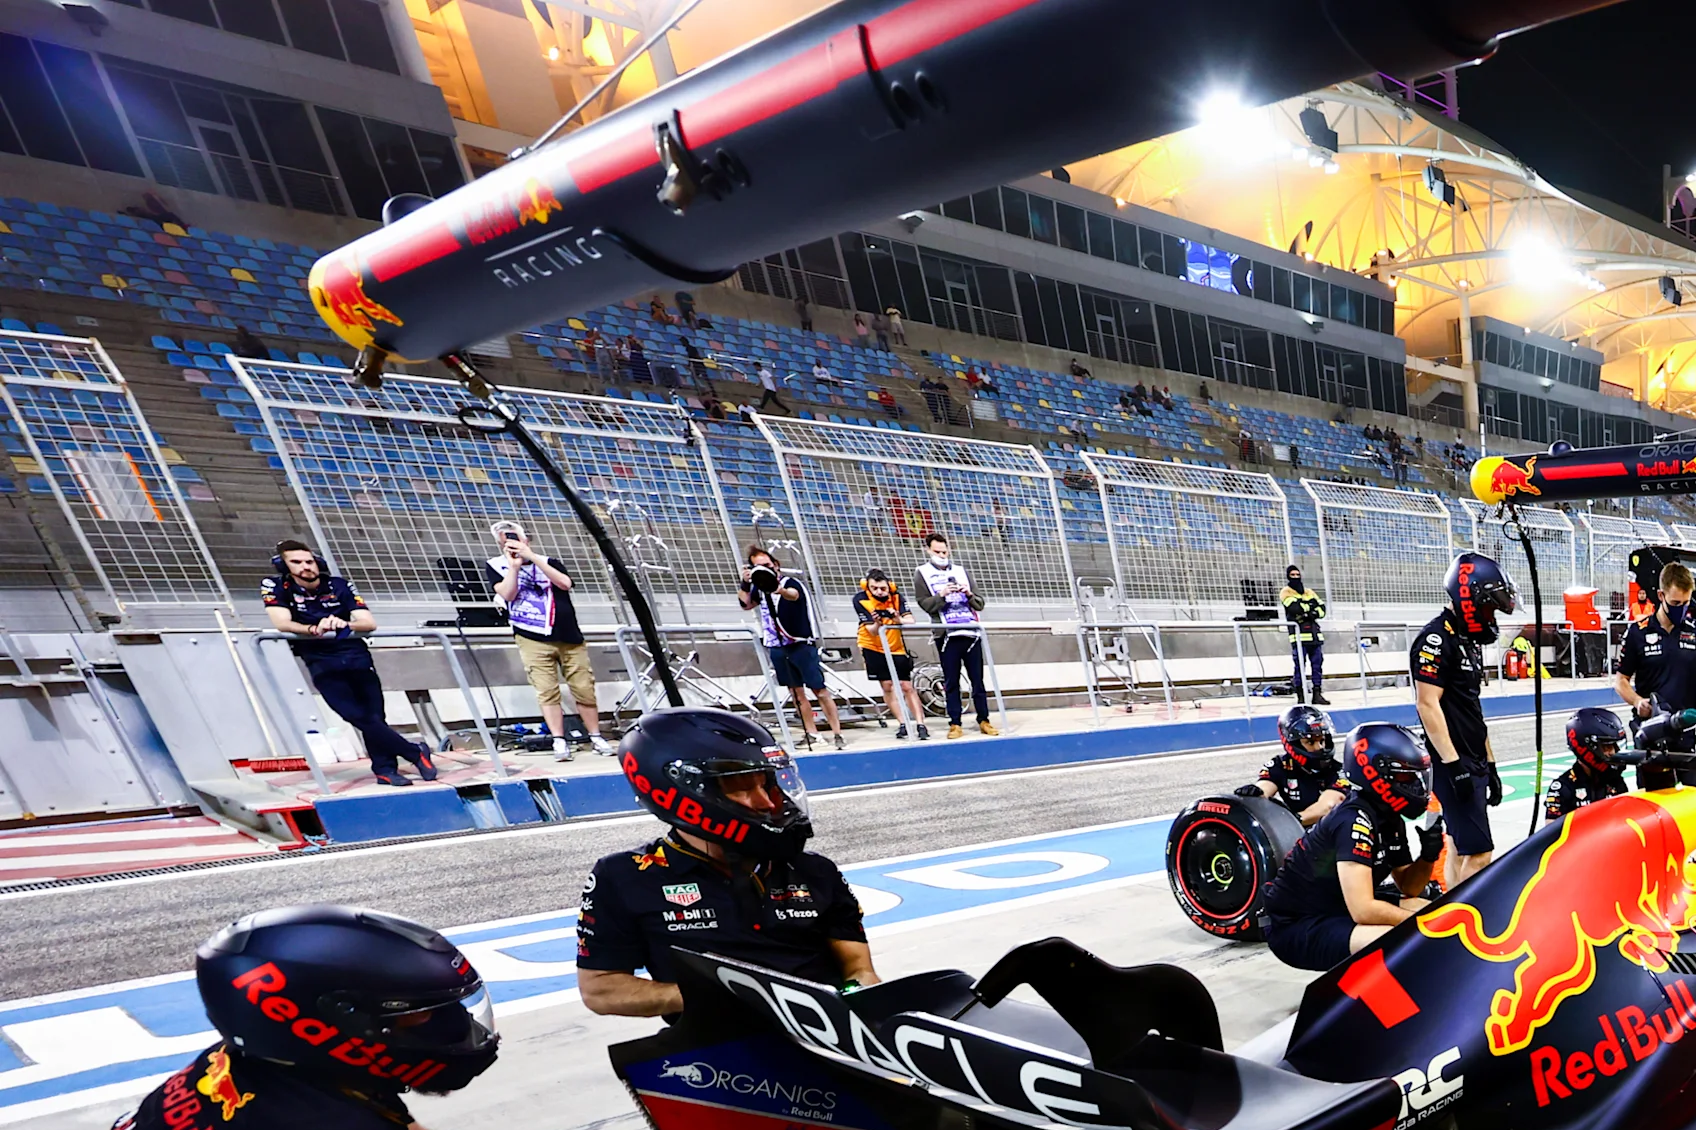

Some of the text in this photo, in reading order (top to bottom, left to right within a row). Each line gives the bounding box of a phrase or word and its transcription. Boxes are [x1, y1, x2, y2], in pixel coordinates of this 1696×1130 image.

[493, 236, 602, 288] RACING
[1352, 738, 1409, 812] Red Bull
[622, 751, 750, 843] Red Bull
[1198, 802, 1231, 815] PIRELLI
[667, 894, 700, 904] HEUER
[668, 885, 696, 894] TAG
[663, 909, 701, 922] Mobil
[667, 921, 719, 931] ORACLE
[786, 909, 818, 919] Tezos
[1192, 915, 1250, 935] P ZERO
[1337, 948, 1421, 1029] 1
[232, 961, 447, 1087] Red Bull
[1530, 1014, 1627, 1107] Red
[690, 1062, 837, 1110] ORGANICS
[1391, 1046, 1464, 1121] RC
[791, 1106, 812, 1118] Red
[813, 1109, 833, 1122] Bull
[1418, 1089, 1464, 1121] RACING
